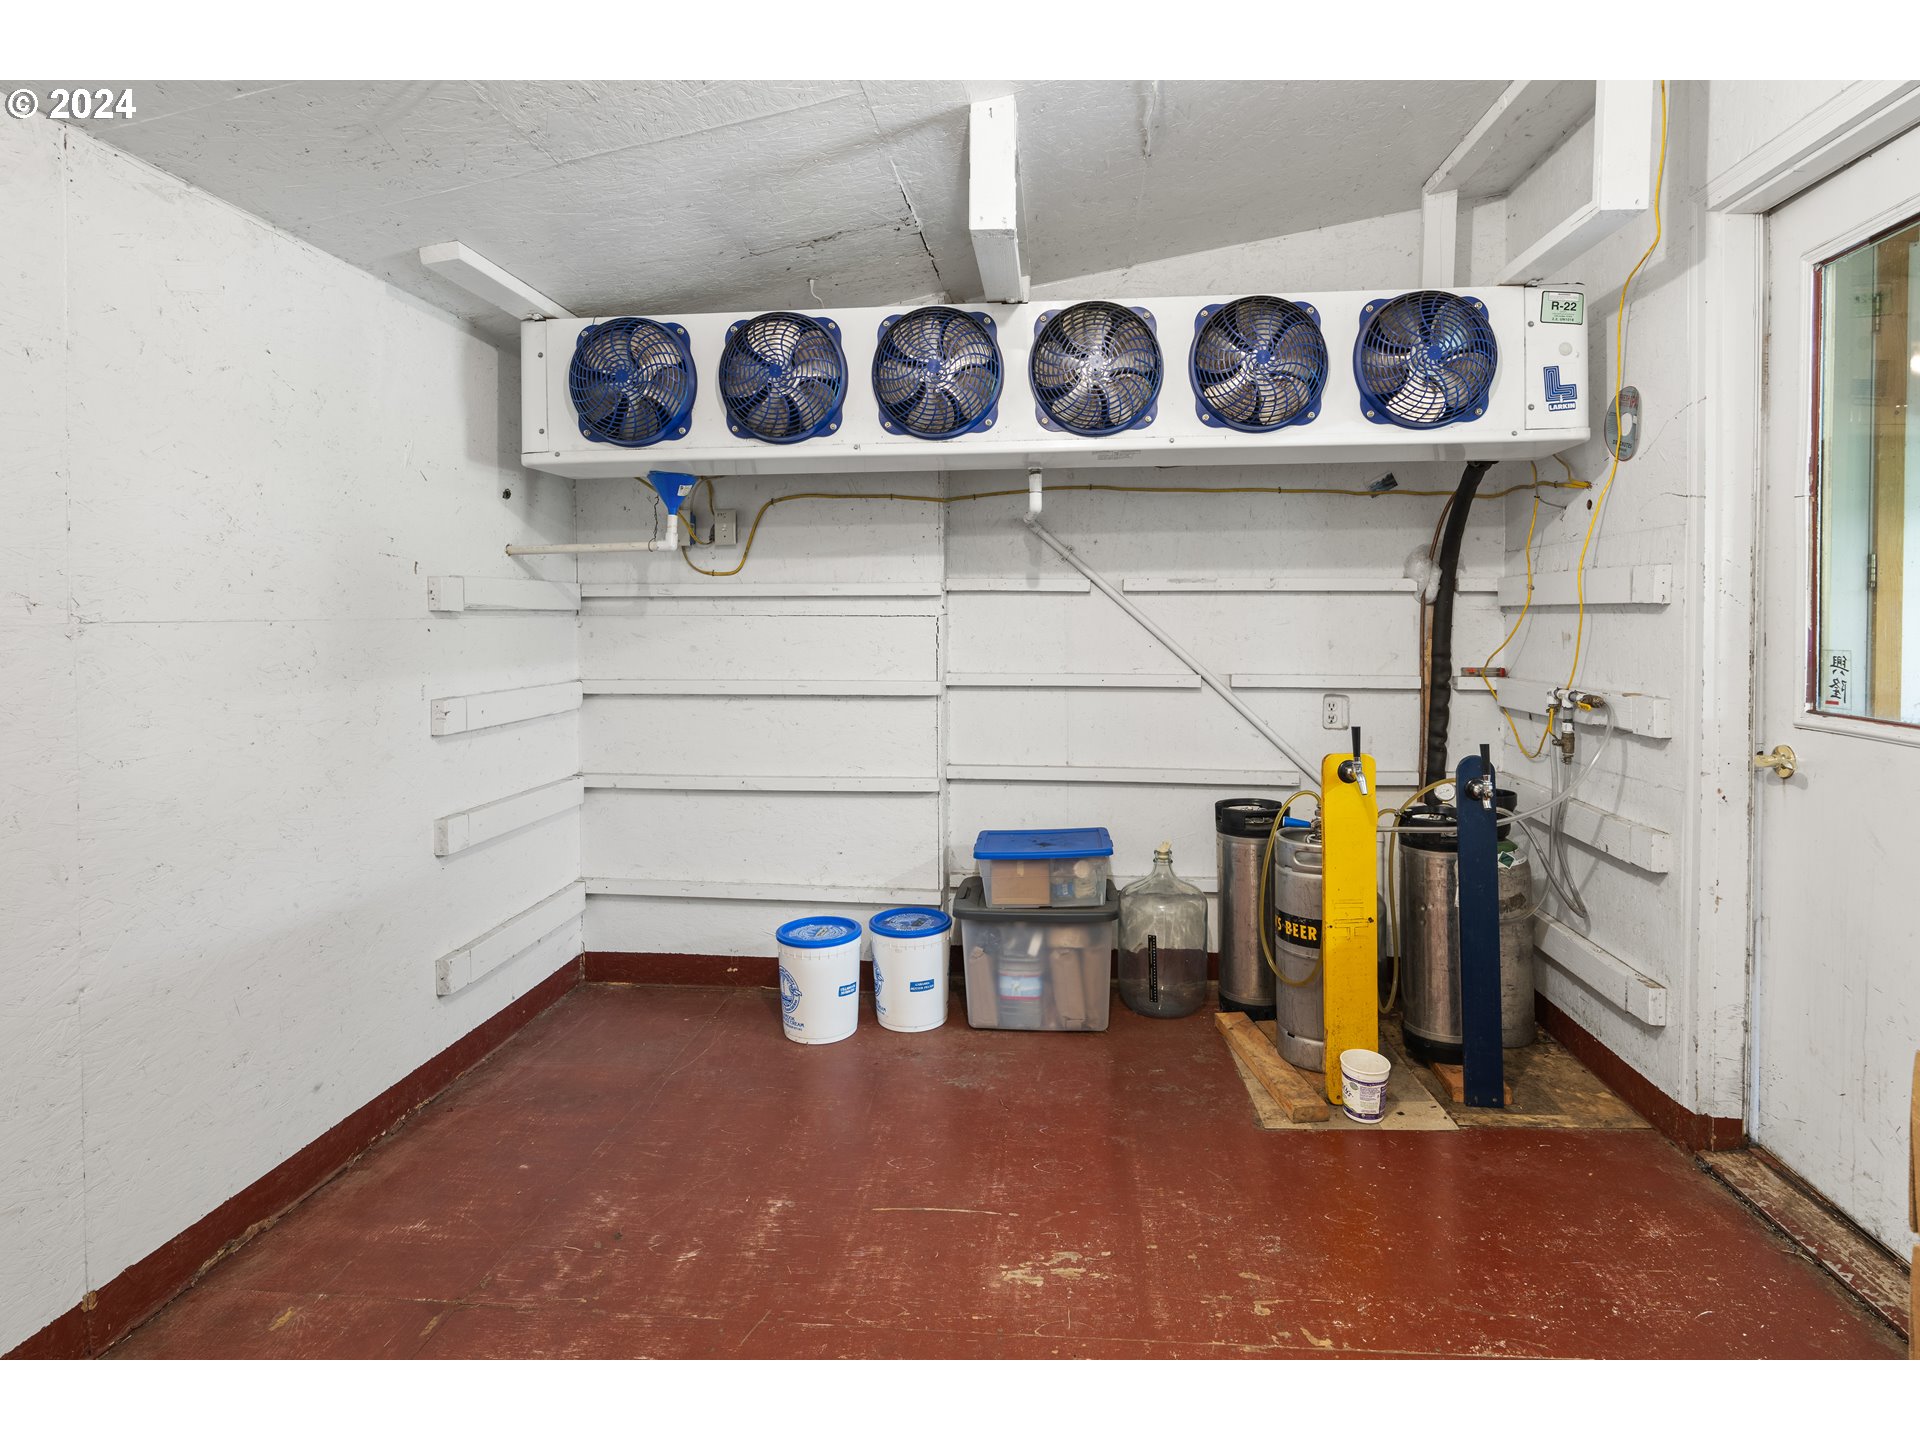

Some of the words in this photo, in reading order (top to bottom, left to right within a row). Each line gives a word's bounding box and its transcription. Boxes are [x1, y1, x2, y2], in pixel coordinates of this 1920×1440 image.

[1551, 300, 1577, 311] R-22
[1549, 402, 1576, 411] LARKIN
[1285, 920, 1317, 941] BEER
